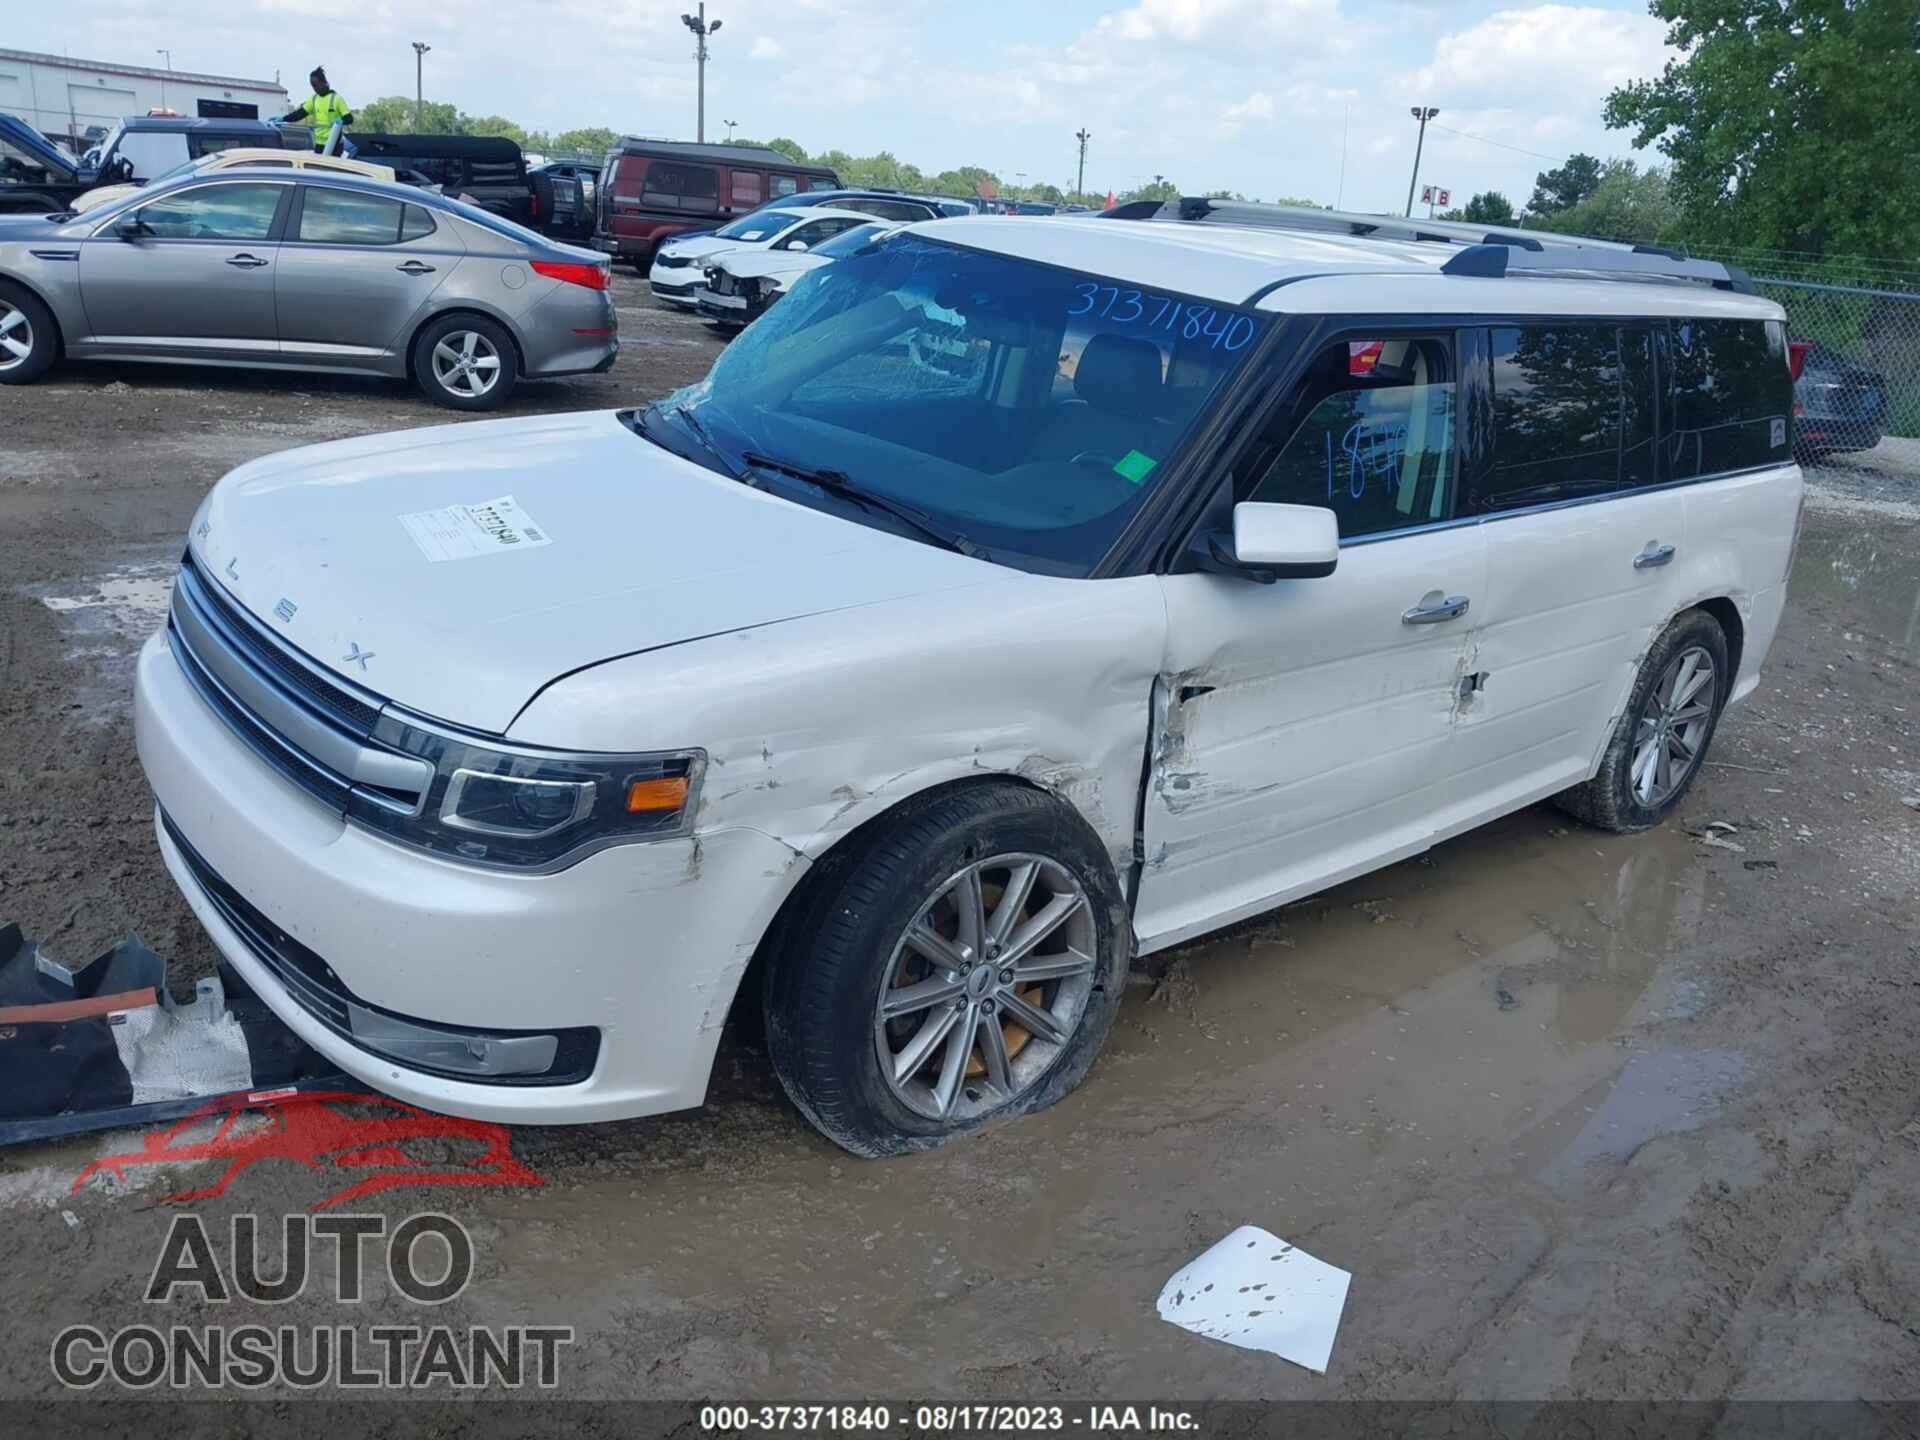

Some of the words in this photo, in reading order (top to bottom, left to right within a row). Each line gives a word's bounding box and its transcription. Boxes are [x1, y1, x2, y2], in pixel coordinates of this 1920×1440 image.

[1423, 188, 1431, 203] A
[1439, 191, 1449, 205] B
[1068, 283, 1254, 350] 37371840
